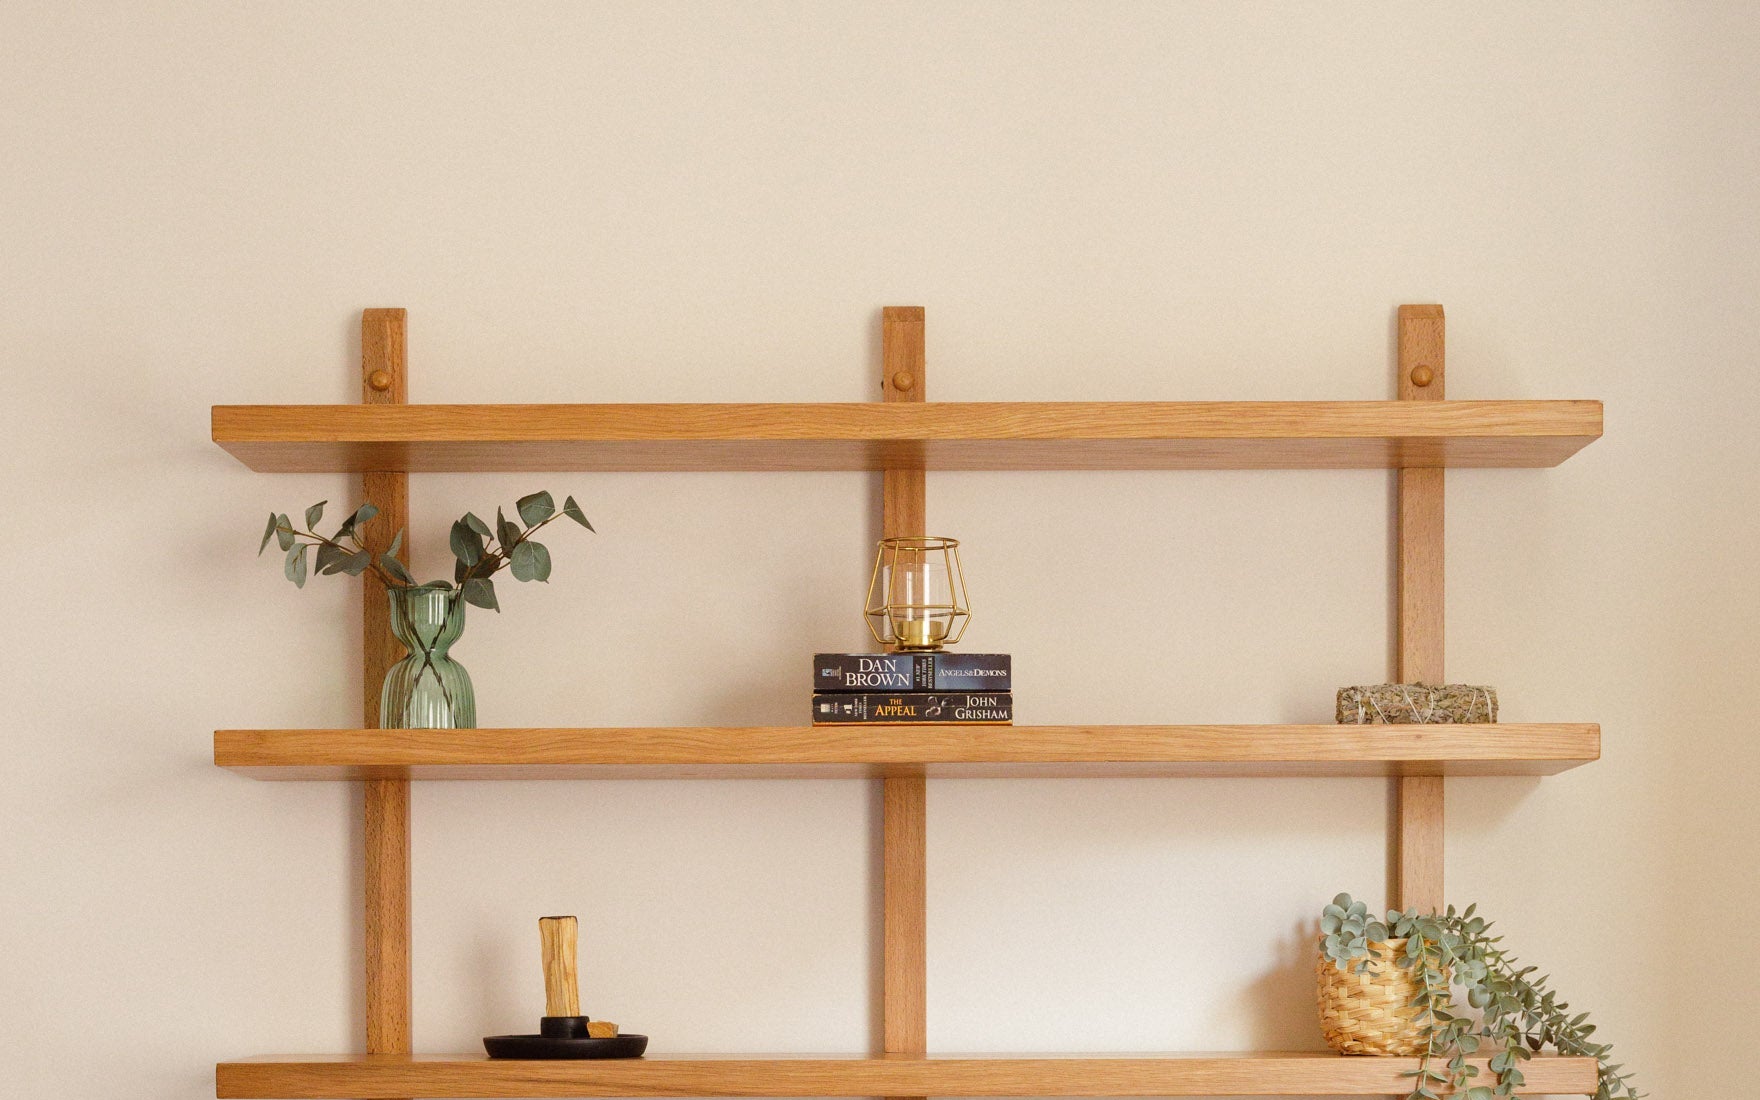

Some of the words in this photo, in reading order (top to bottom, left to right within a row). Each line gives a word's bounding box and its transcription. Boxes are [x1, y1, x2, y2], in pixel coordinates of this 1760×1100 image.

[859, 658, 896, 673] DAN
[845, 672, 910, 687] BROWN
[889, 698, 903, 706] THE
[966, 695, 997, 708] JOHN
[875, 706, 917, 717] APPEAL
[955, 708, 1008, 720] GRISHAM
